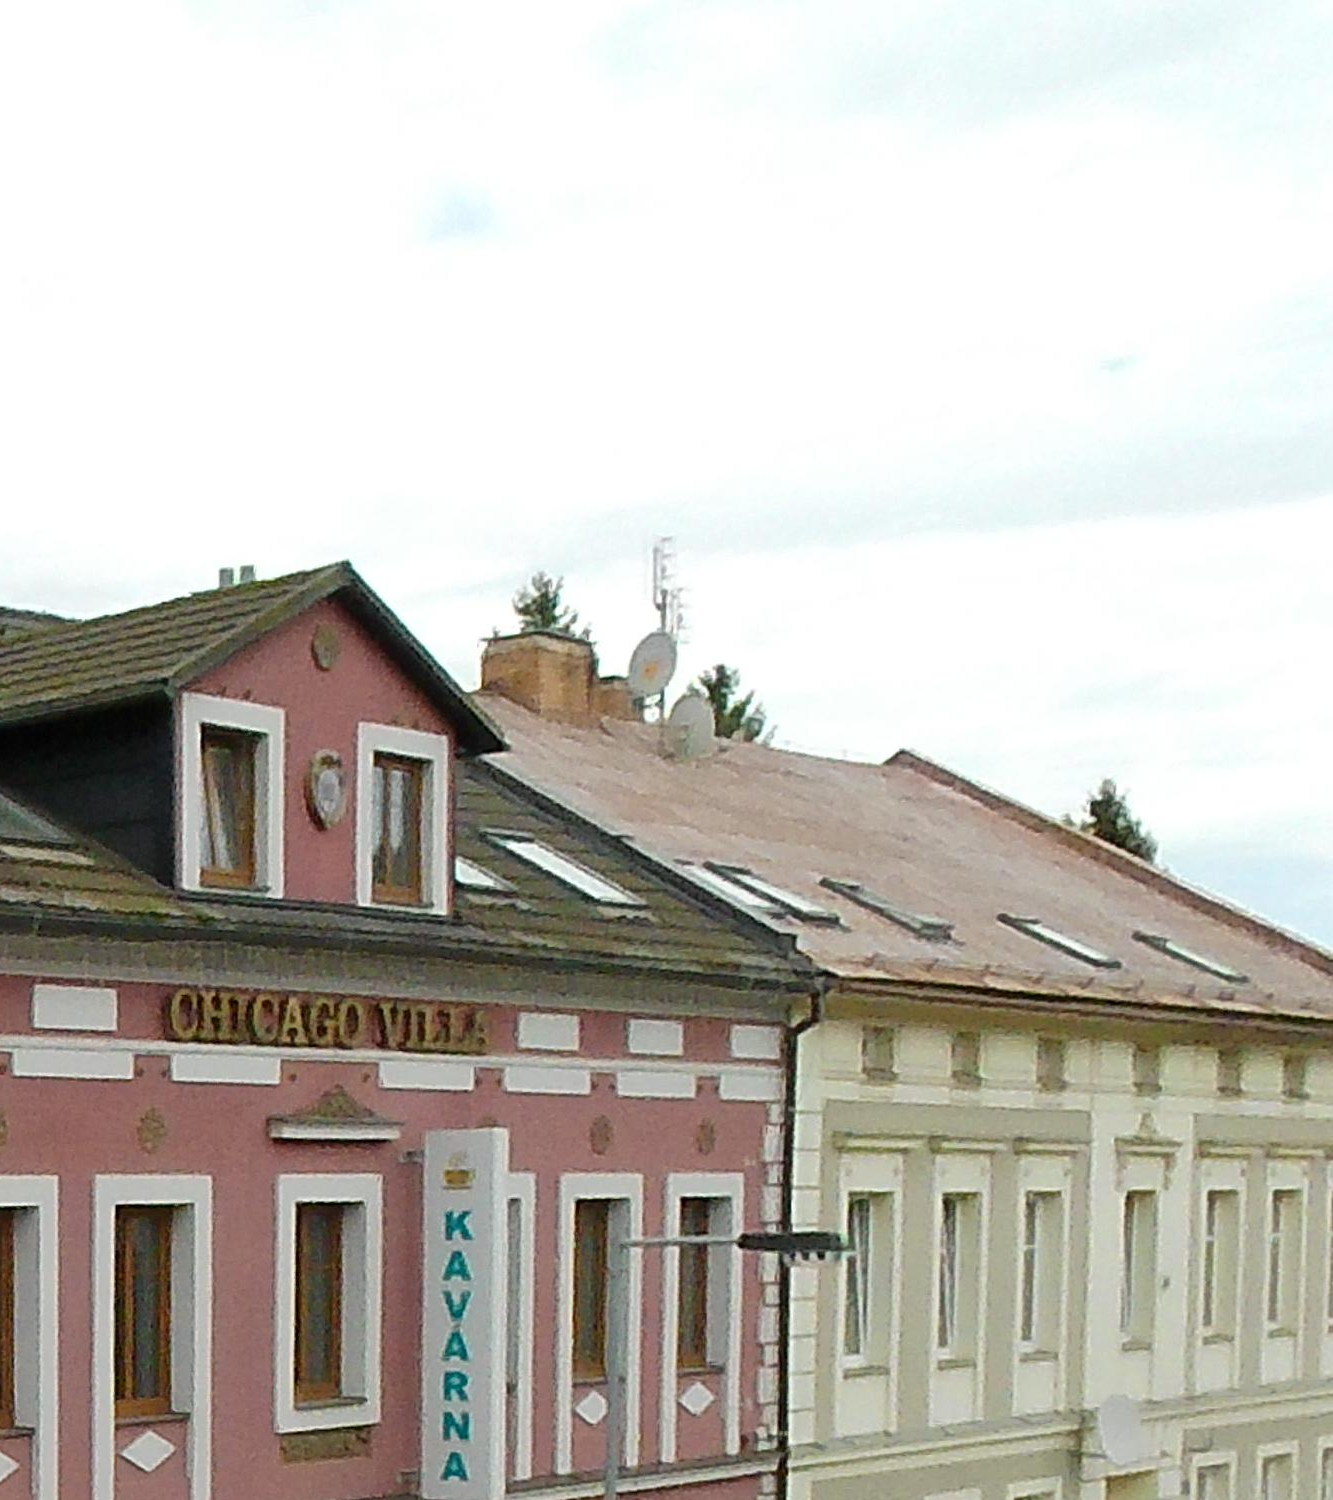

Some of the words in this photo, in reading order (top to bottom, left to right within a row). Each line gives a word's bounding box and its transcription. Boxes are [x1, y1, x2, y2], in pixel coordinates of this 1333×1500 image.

[169, 987, 363, 1046] CHICAGO
[378, 1000, 490, 1053] VILLA
[440, 1209, 474, 1482] KAVÁRNA
